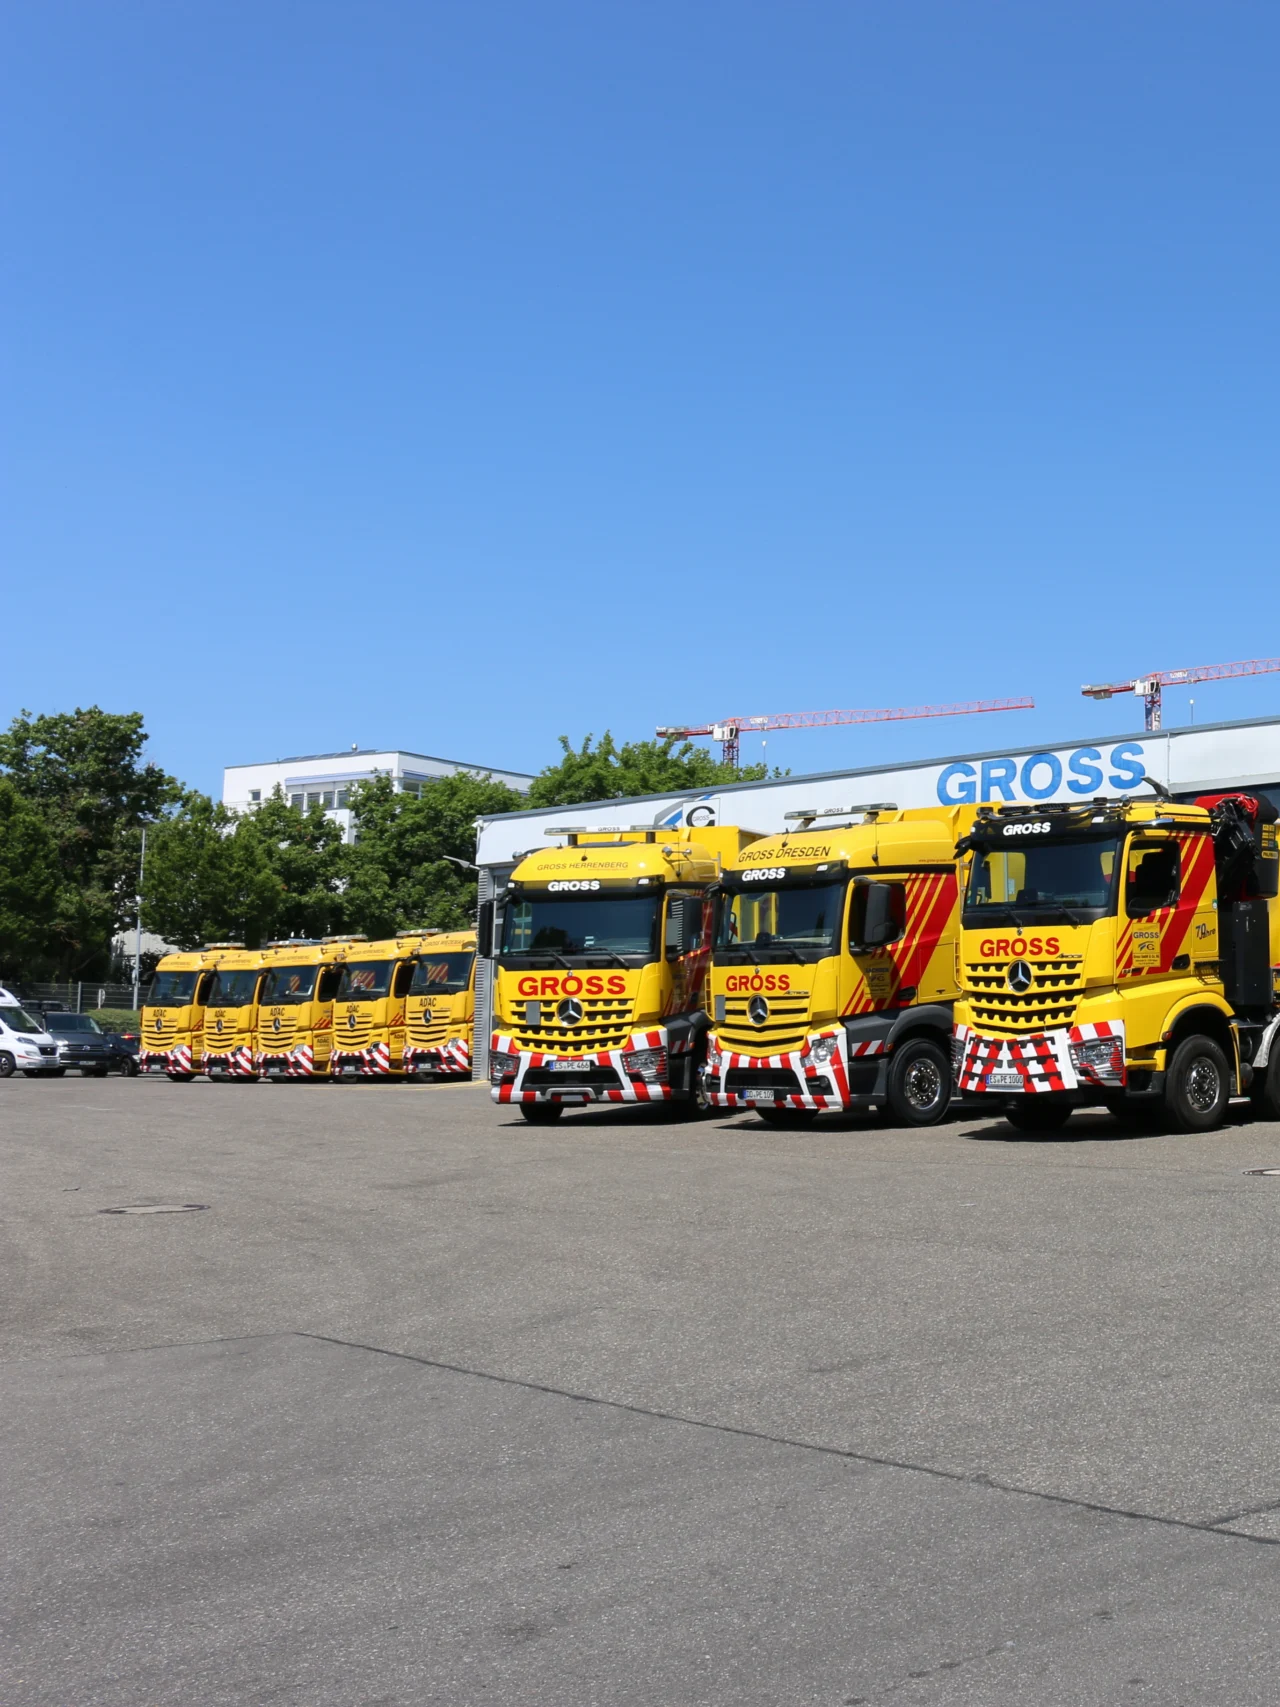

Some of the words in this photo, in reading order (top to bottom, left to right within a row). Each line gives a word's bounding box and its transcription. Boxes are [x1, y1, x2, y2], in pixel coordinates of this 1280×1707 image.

[937, 743, 1146, 806] GROSS
[1002, 822, 1051, 836] GROSS
[738, 848, 775, 863] GROSS
[776, 846, 831, 859] DRESDEN
[537, 862, 567, 871] GROSS
[569, 861, 629, 870] HERRENBERG
[741, 868, 786, 882] GROSS
[548, 881, 600, 892] GROSS
[1133, 931, 1159, 939] GROSS
[980, 937, 1060, 957] GROSS
[518, 975, 626, 996] GROSS
[726, 974, 790, 992] GROSS
[419, 998, 437, 1007] ADAC
[153, 1009, 167, 1018] ADAC
[214, 1009, 226, 1018] ADAC
[270, 1007, 285, 1017] ADAC
[346, 1005, 359, 1013] ADAC
[554, 1061, 564, 1070] ES
[567, 1061, 576, 1070] PE
[577, 1061, 590, 1069] 466
[989, 1074, 997, 1084] ES
[1000, 1074, 1008, 1084] PE
[1009, 1074, 1023, 1084] 1000
